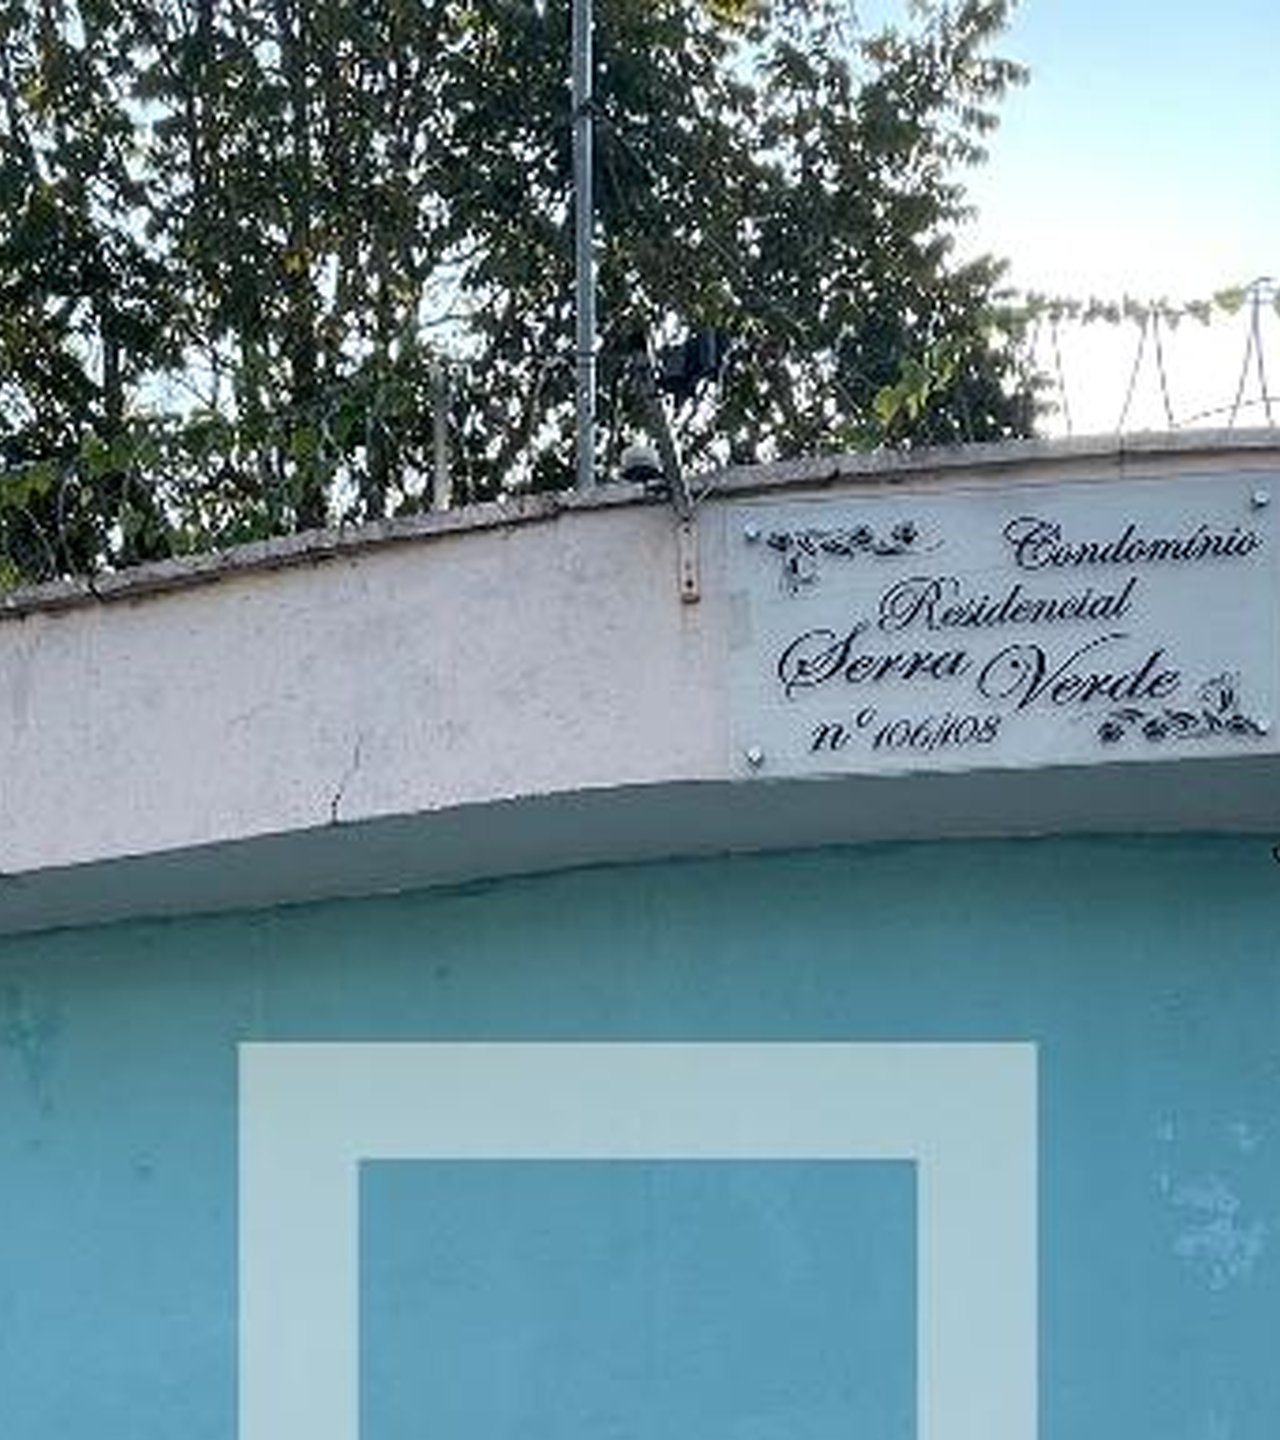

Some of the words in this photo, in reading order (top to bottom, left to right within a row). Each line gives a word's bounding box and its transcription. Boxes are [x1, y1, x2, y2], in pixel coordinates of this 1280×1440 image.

[1002, 516, 1263, 571] Condomínio
[877, 576, 1138, 631] Residencial
[776, 618, 970, 702] Serra
[976, 631, 1182, 711] Verde
